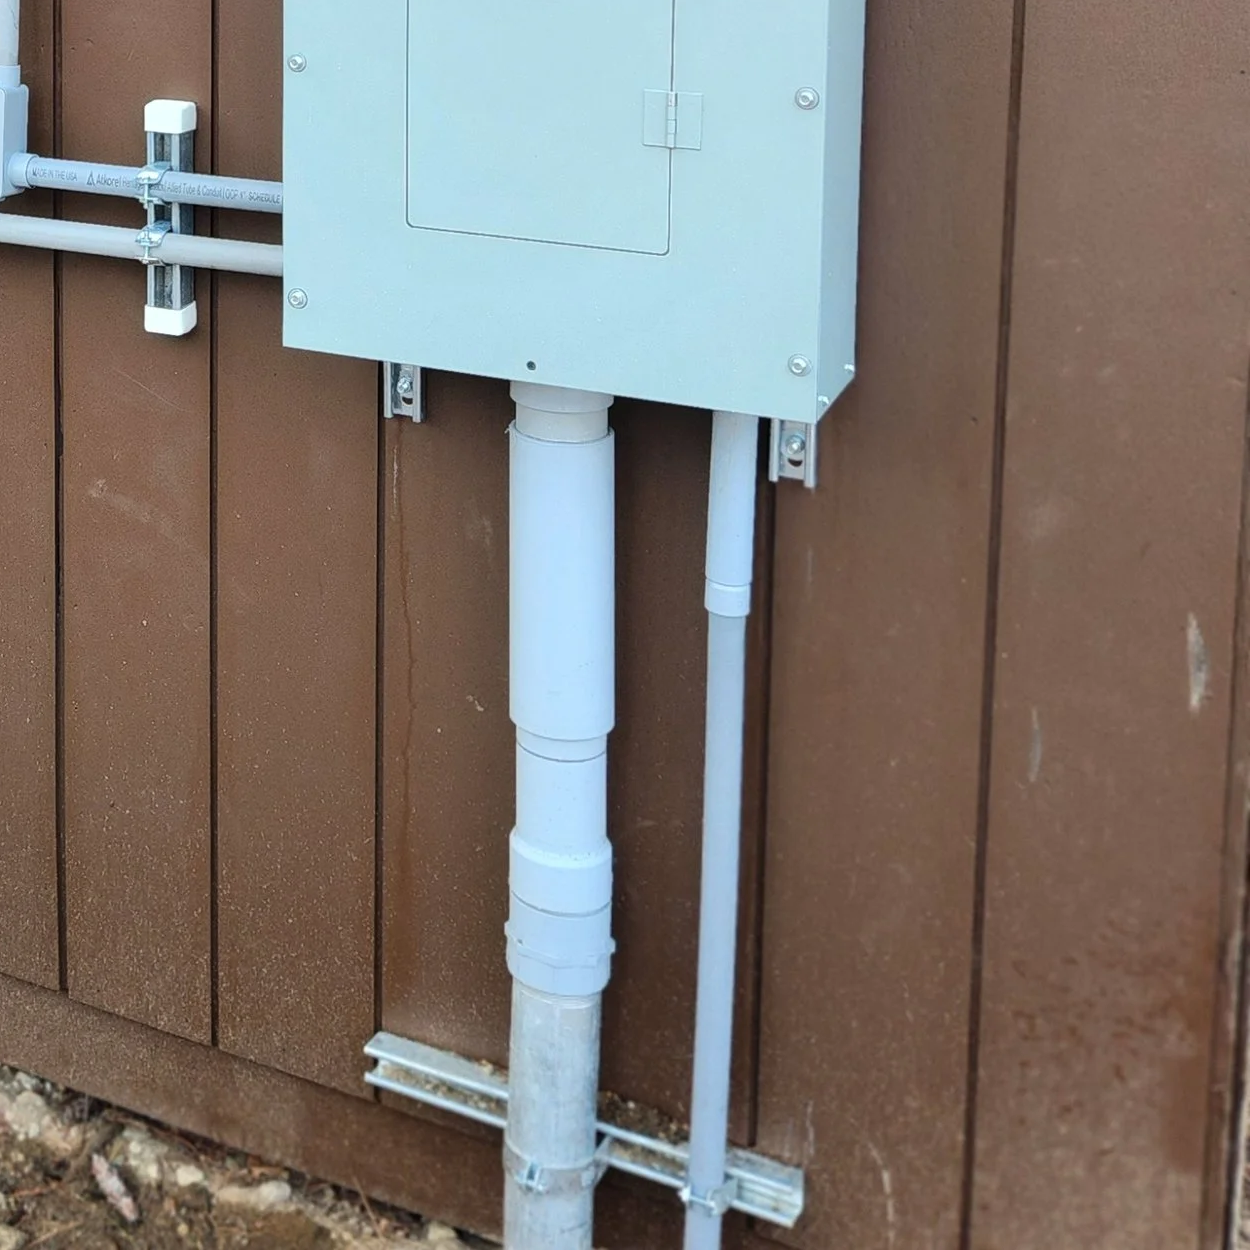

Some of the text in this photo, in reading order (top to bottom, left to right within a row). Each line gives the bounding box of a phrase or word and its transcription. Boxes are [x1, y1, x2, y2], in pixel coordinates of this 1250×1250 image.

[32, 167, 78, 182] MADE IN THE USA
[95, 173, 119, 188] Atkore
[183, 183, 197, 195] Tube
[248, 191, 281, 205] SCHEDULE
